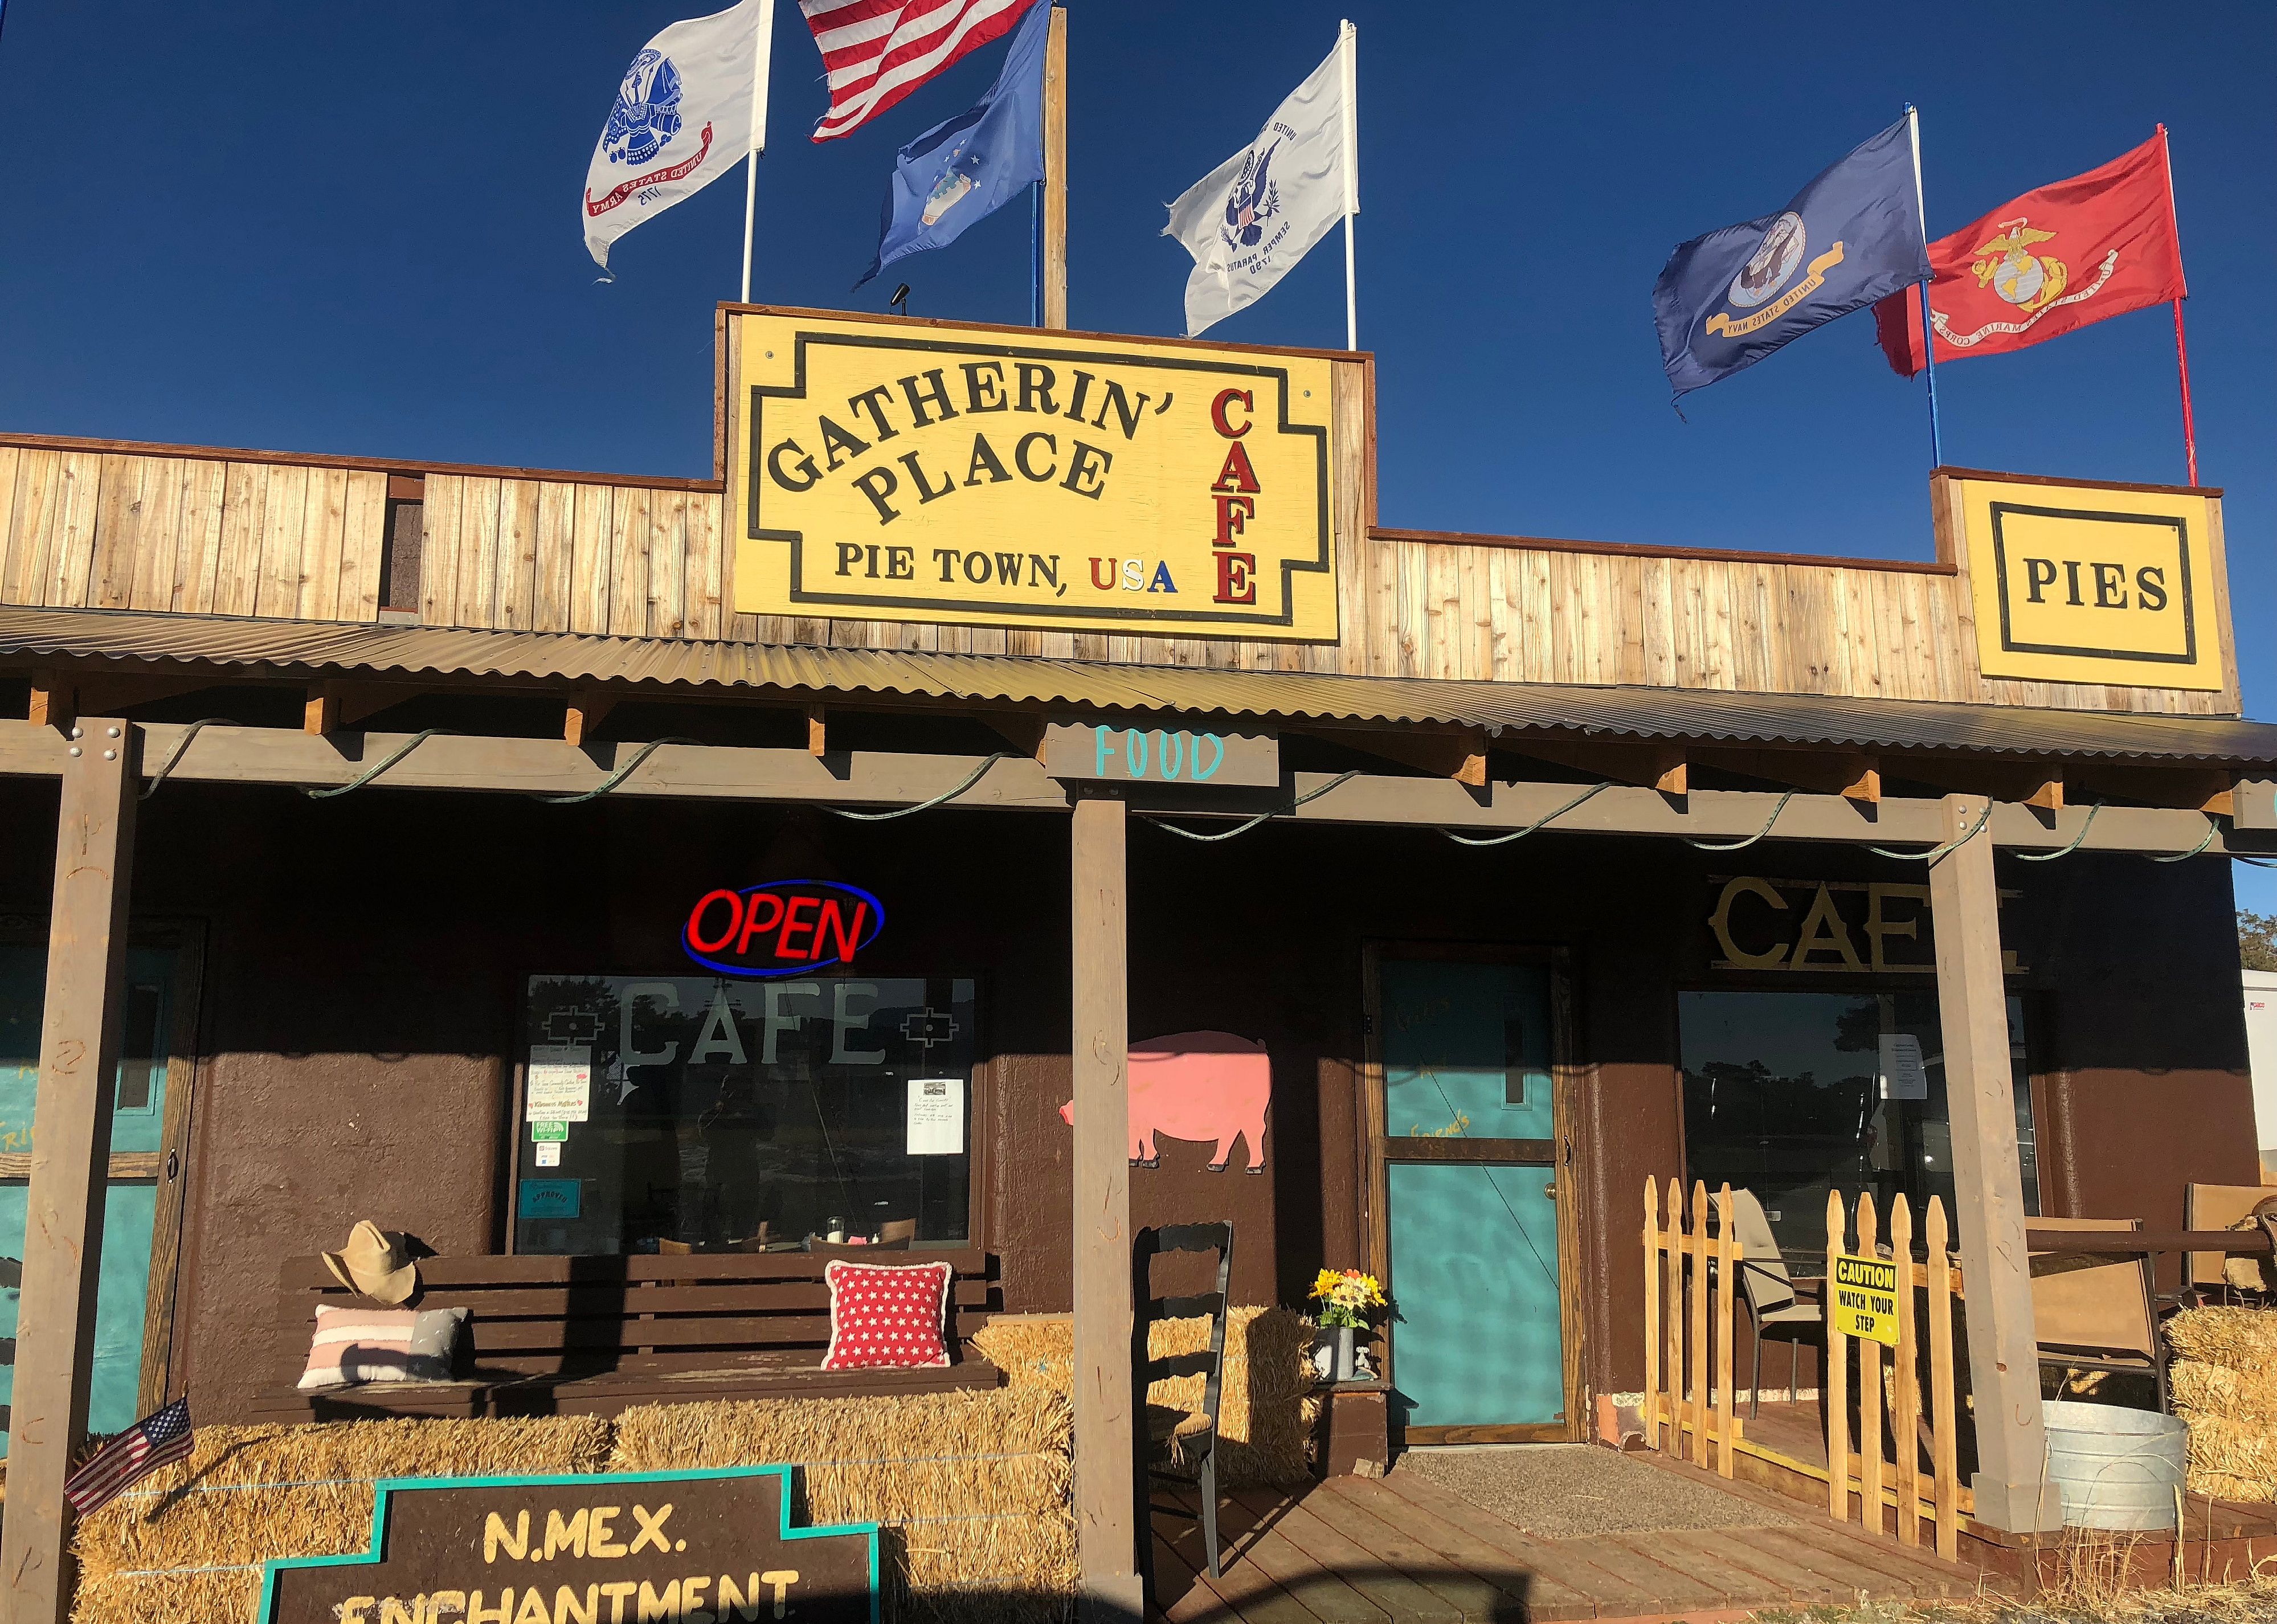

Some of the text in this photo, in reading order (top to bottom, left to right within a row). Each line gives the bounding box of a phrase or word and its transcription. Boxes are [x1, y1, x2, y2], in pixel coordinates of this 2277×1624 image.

[767, 361, 1173, 493] GATHERIN'
[851, 431, 1113, 525] PLACE
[1211, 387, 1261, 606] CAFE
[835, 541, 1178, 598] PIE TOWN, USA
[2023, 558, 2168, 612] PIES
[1095, 725, 1224, 780] FOOD
[686, 889, 867, 963] OPEN
[1708, 876, 2020, 973] CAF
[619, 981, 886, 1066] CAFE
[1838, 1261, 1894, 1289] CAUTION
[1838, 1290, 1894, 1316] WATCH YOUR
[1855, 1314, 1875, 1333] STEP
[483, 1503, 688, 1564] N.MEX.
